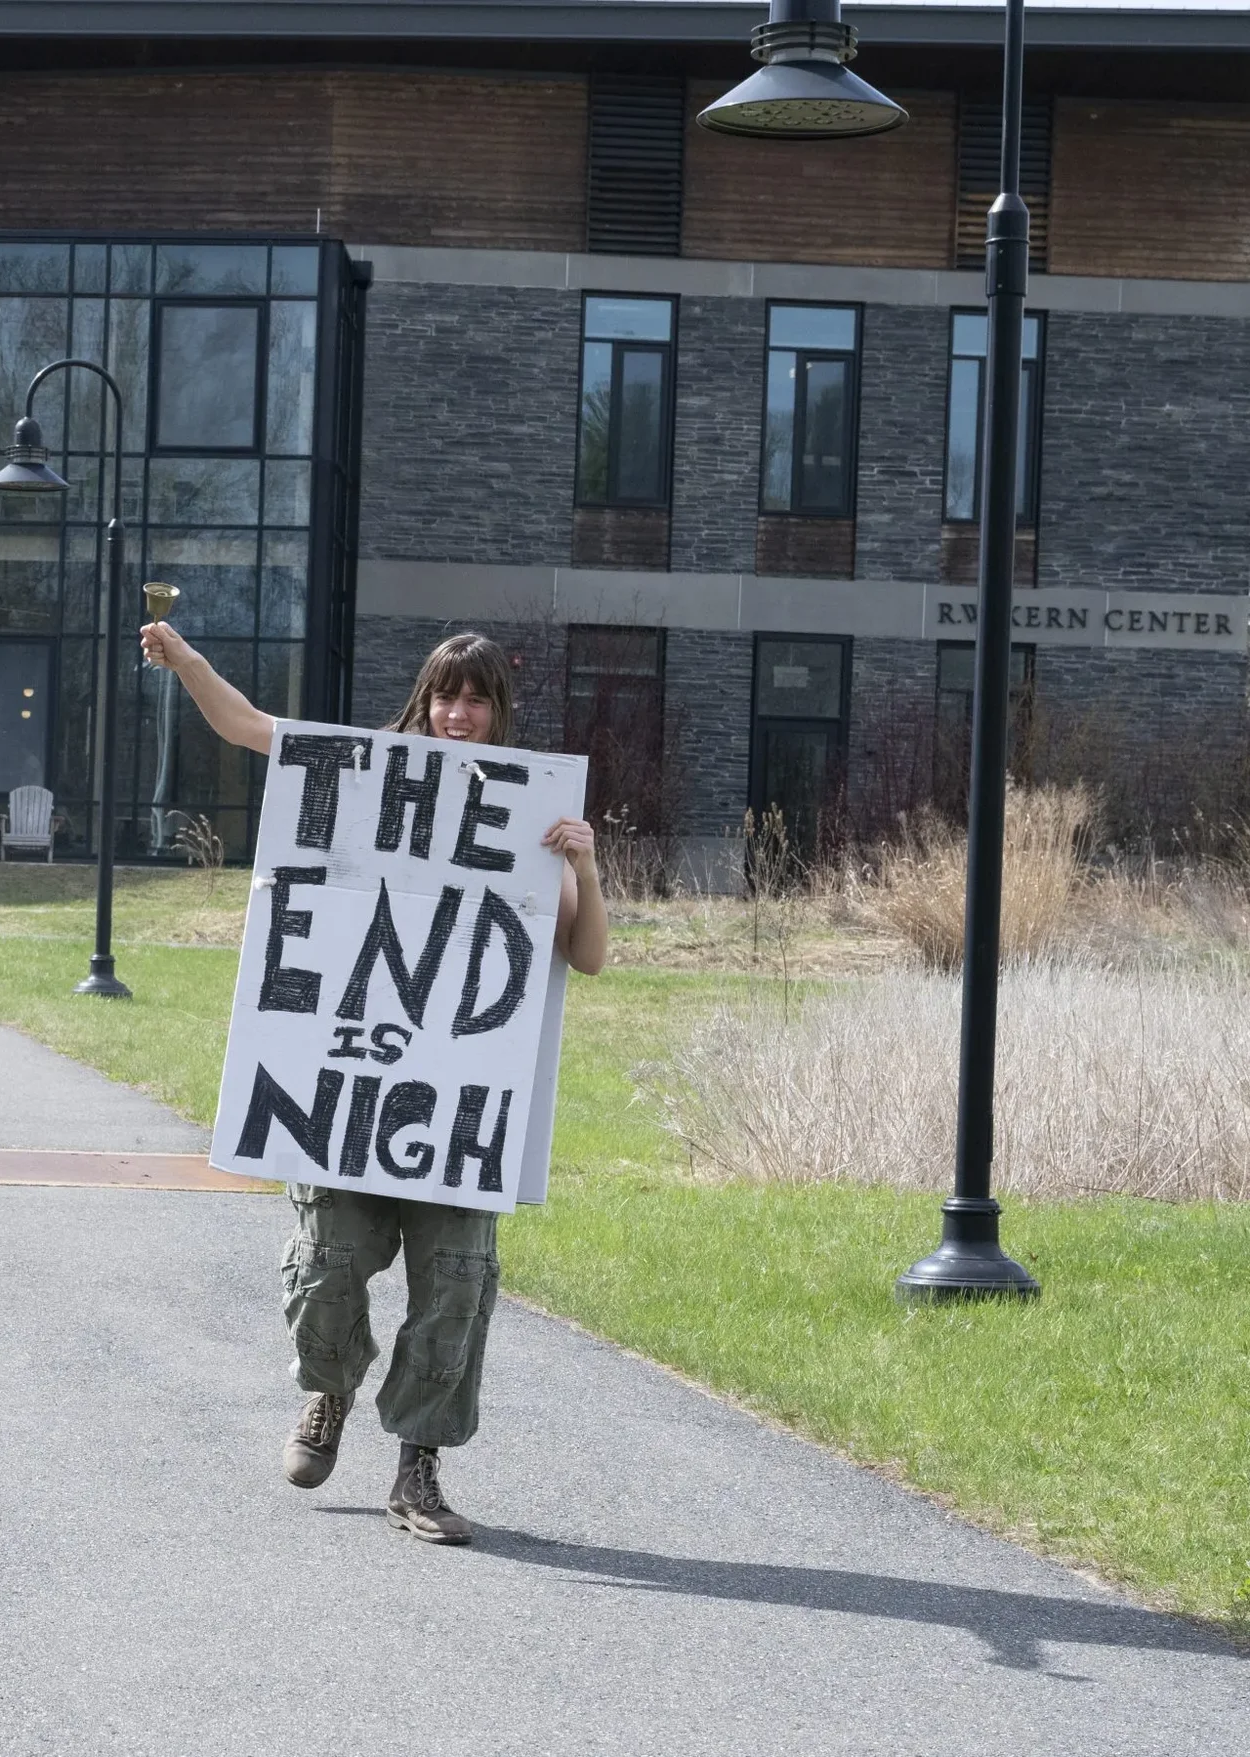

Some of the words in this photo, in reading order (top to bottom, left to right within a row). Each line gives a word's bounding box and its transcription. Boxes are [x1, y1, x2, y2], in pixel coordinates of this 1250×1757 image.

[1104, 608, 1234, 636] CENTER
[278, 732, 530, 873] THE
[257, 865, 534, 1039] END
[327, 1022, 413, 1066] IS
[234, 1060, 515, 1194] NIGH
